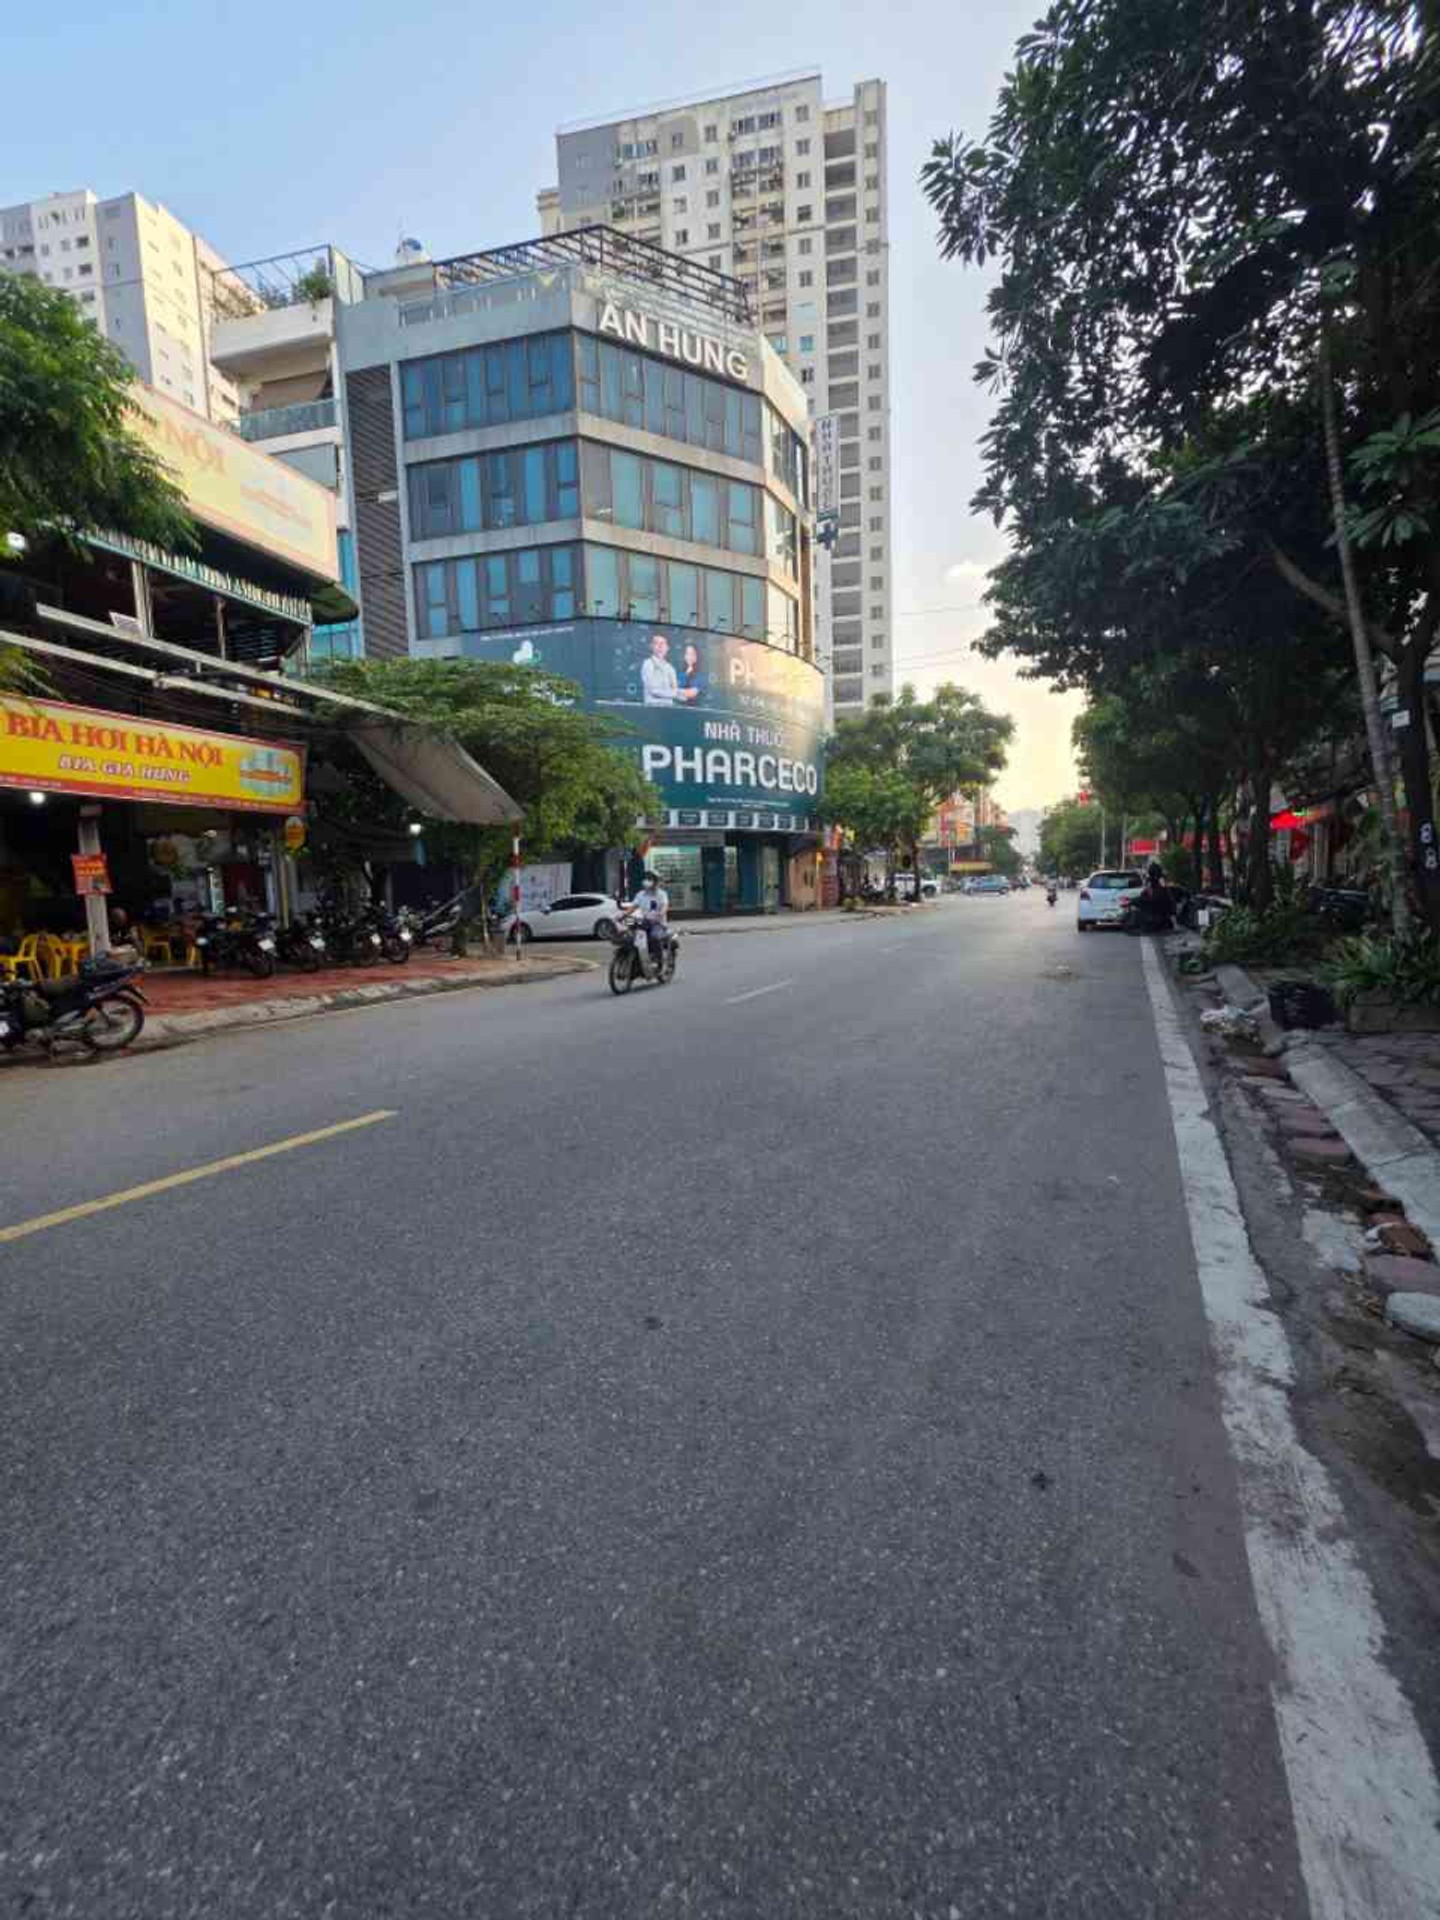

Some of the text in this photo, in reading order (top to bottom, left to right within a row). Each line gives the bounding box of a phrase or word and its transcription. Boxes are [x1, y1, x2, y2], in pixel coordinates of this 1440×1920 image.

[6, 710, 66, 743] BIA
[134, 732, 175, 759] HÀ
[178, 741, 224, 768] NỘI
[703, 720, 741, 742] NHÀ
[642, 744, 818, 796] PHARCECO
